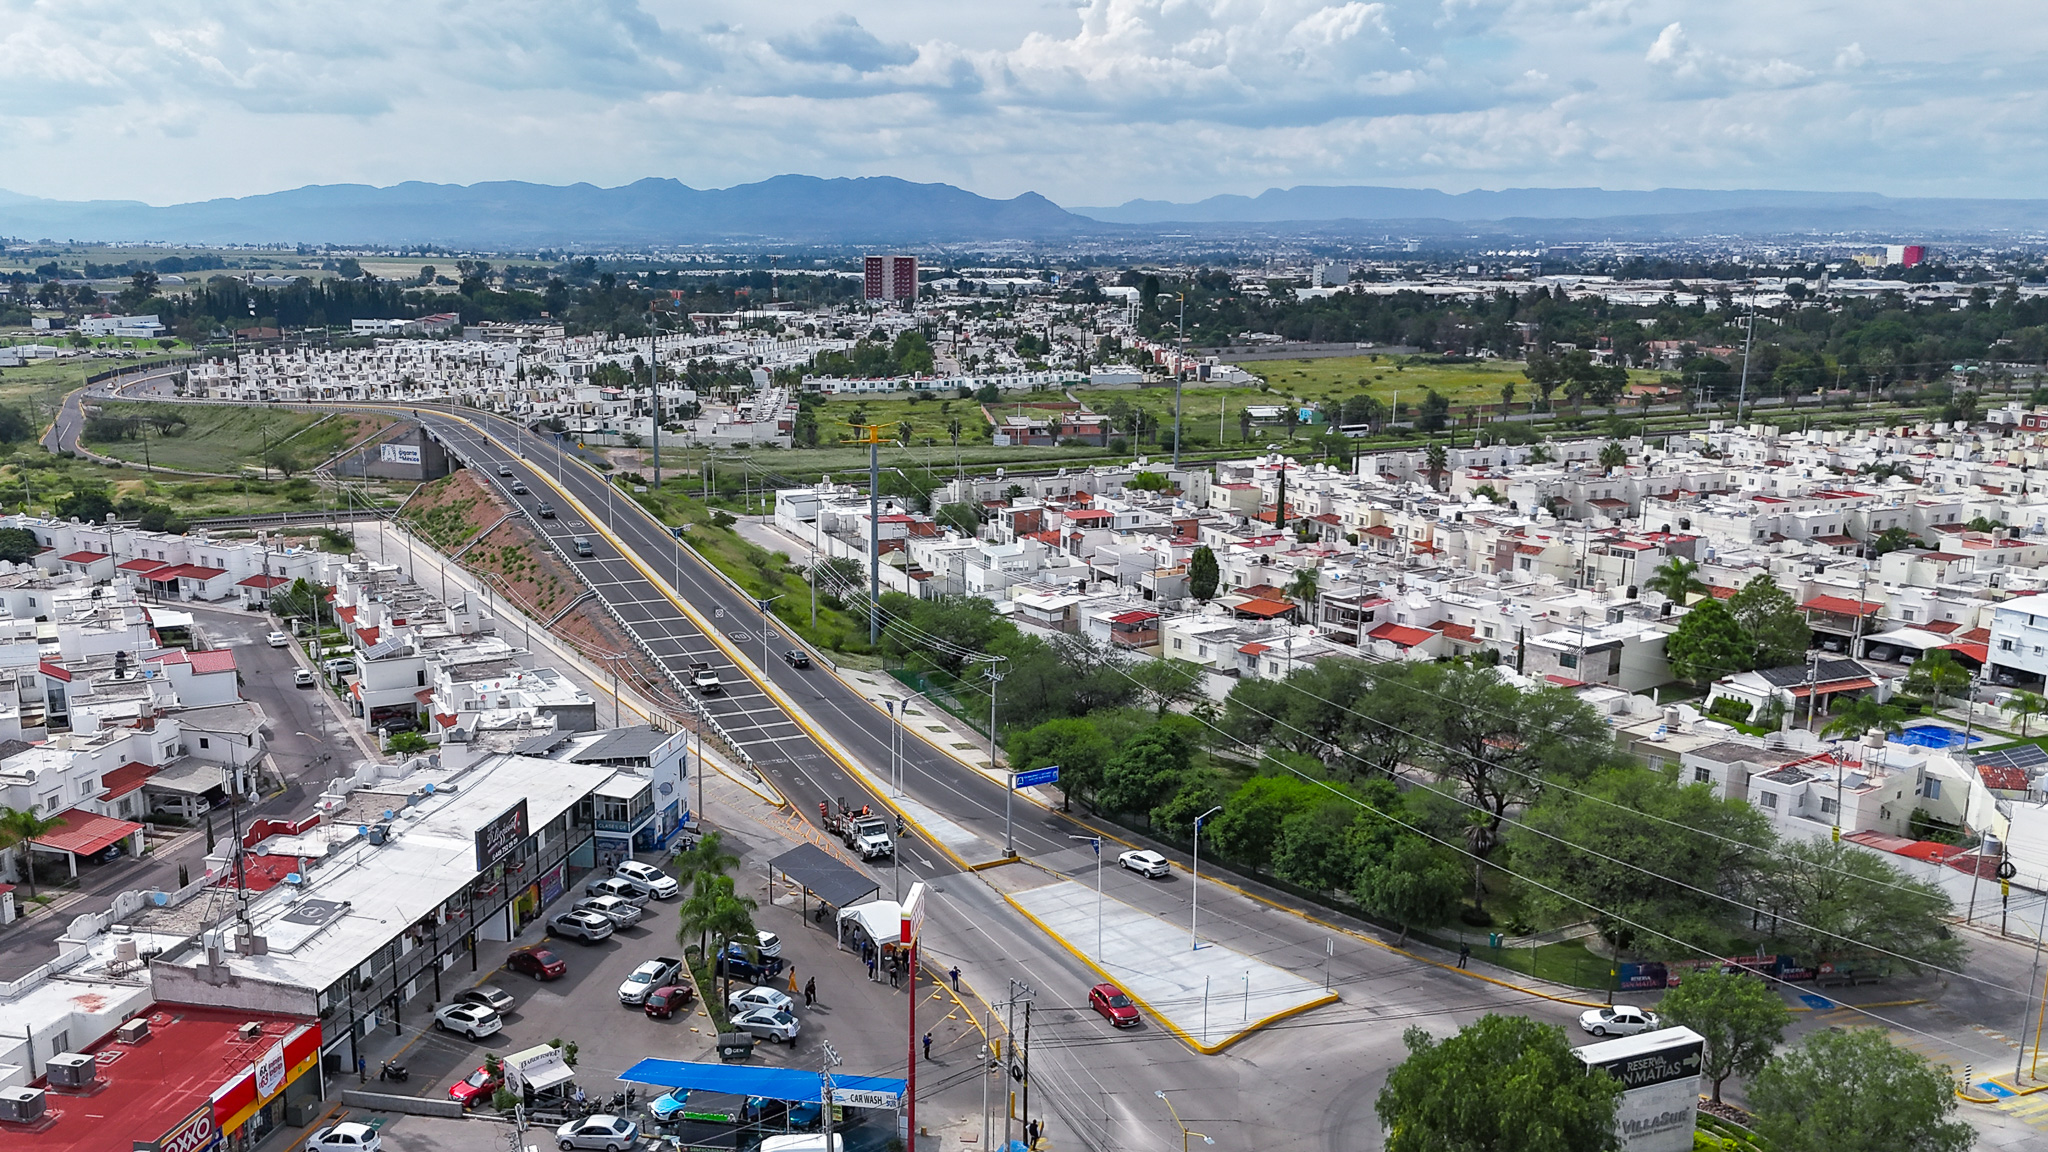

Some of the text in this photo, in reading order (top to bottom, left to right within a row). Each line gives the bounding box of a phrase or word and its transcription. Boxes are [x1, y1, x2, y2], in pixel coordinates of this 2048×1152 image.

[1627, 1056, 1664, 1072] RESERVA
[850, 1094, 883, 1105] CAR WASH
